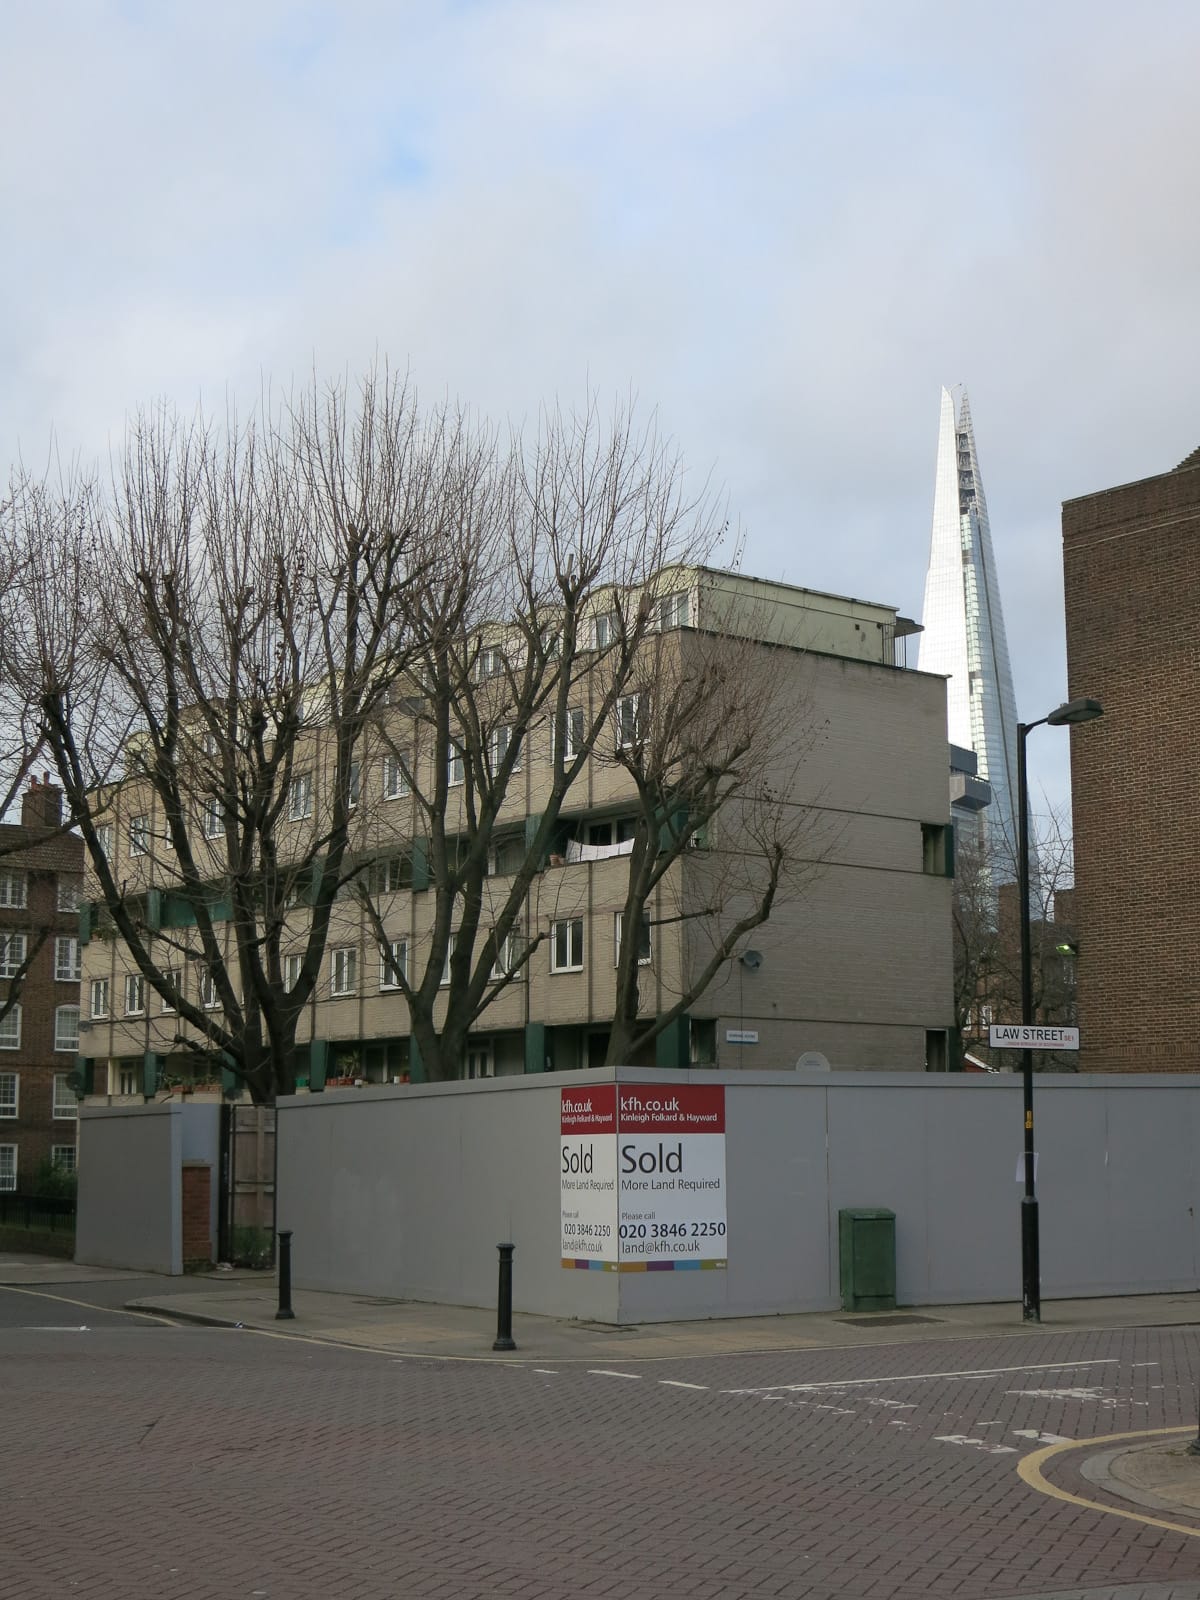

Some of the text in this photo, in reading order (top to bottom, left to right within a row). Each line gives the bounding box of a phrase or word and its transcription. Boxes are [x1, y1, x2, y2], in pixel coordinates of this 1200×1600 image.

[995, 1028, 1020, 1040] LAW
[1022, 1029, 1065, 1041] STREET
[561, 1099, 593, 1113] kfh.co.uk
[620, 1096, 680, 1111] kfh.co.uk
[620, 1113, 650, 1124] Kinleigh
[651, 1113, 678, 1122] Folkard
[686, 1113, 718, 1124] Hayward
[562, 1143, 593, 1174] Sold
[621, 1142, 683, 1174] Sold
[621, 1178, 720, 1192] More Land Required
[621, 1211, 656, 1220] Please call
[564, 1223, 611, 1237] 020 3846 2250
[619, 1222, 726, 1239] 020 3846 2250
[622, 1240, 700, 1254] land@kfh.co.uk
